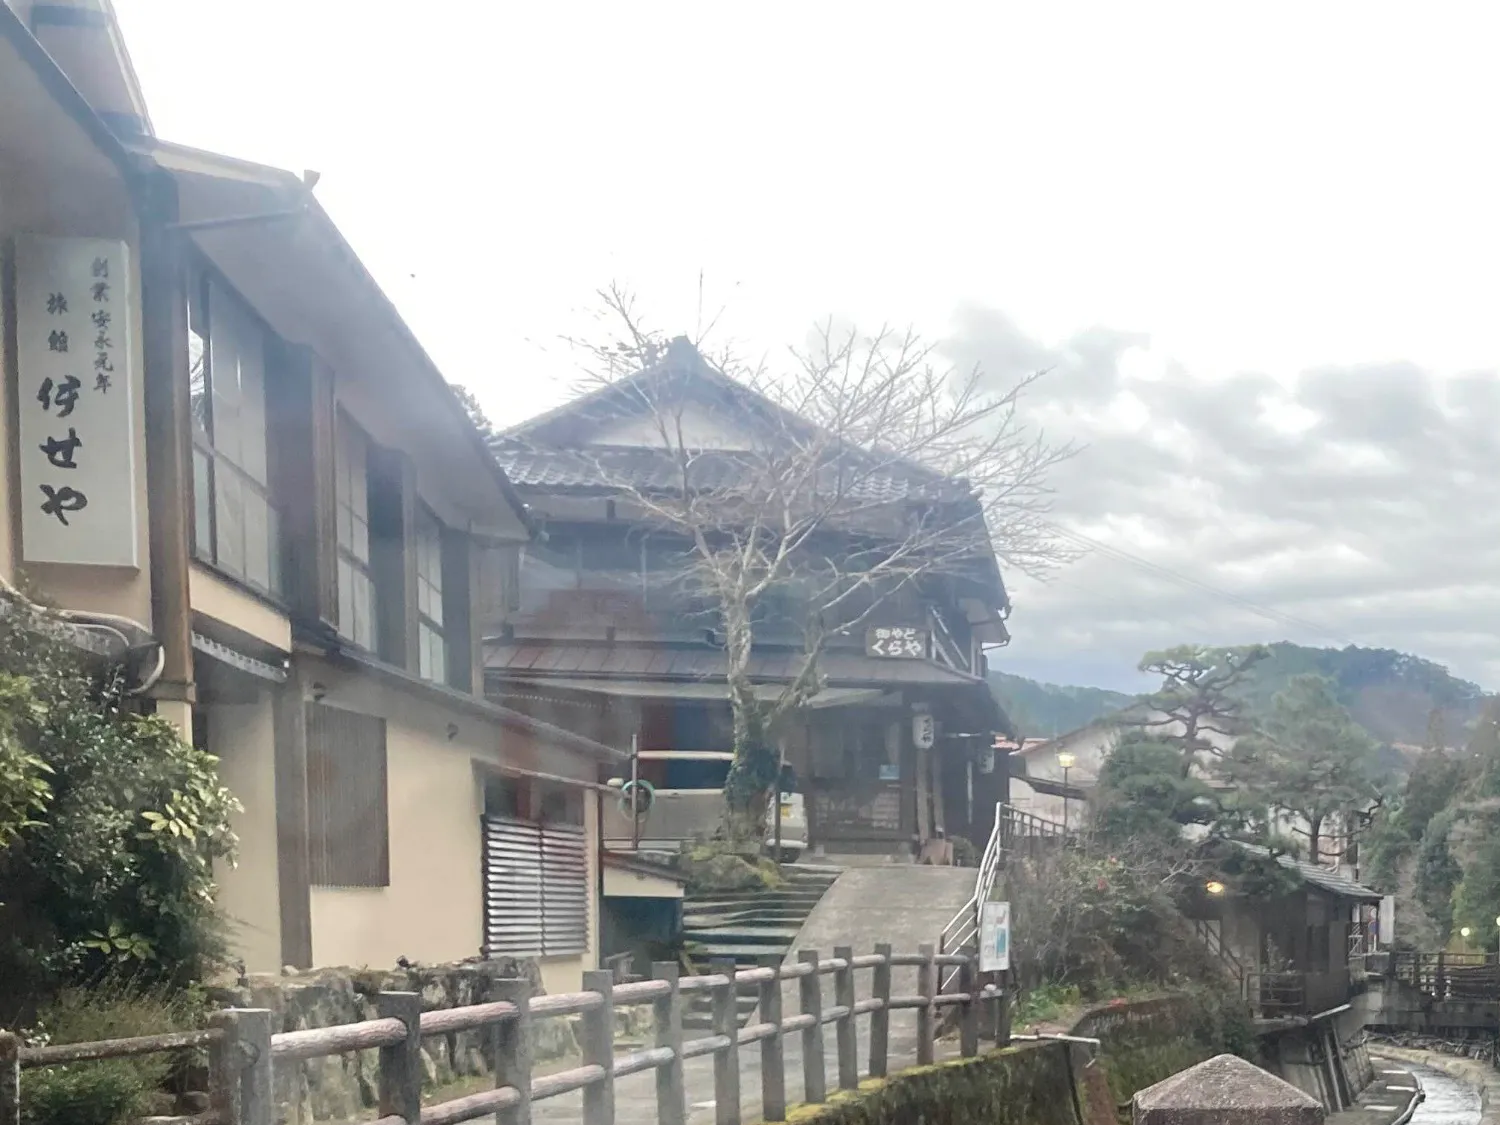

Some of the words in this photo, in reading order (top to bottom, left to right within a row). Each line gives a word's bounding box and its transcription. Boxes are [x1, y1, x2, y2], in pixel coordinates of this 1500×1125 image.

[36, 374, 89, 527] 伊せや
[871, 639, 922, 657] くらや
